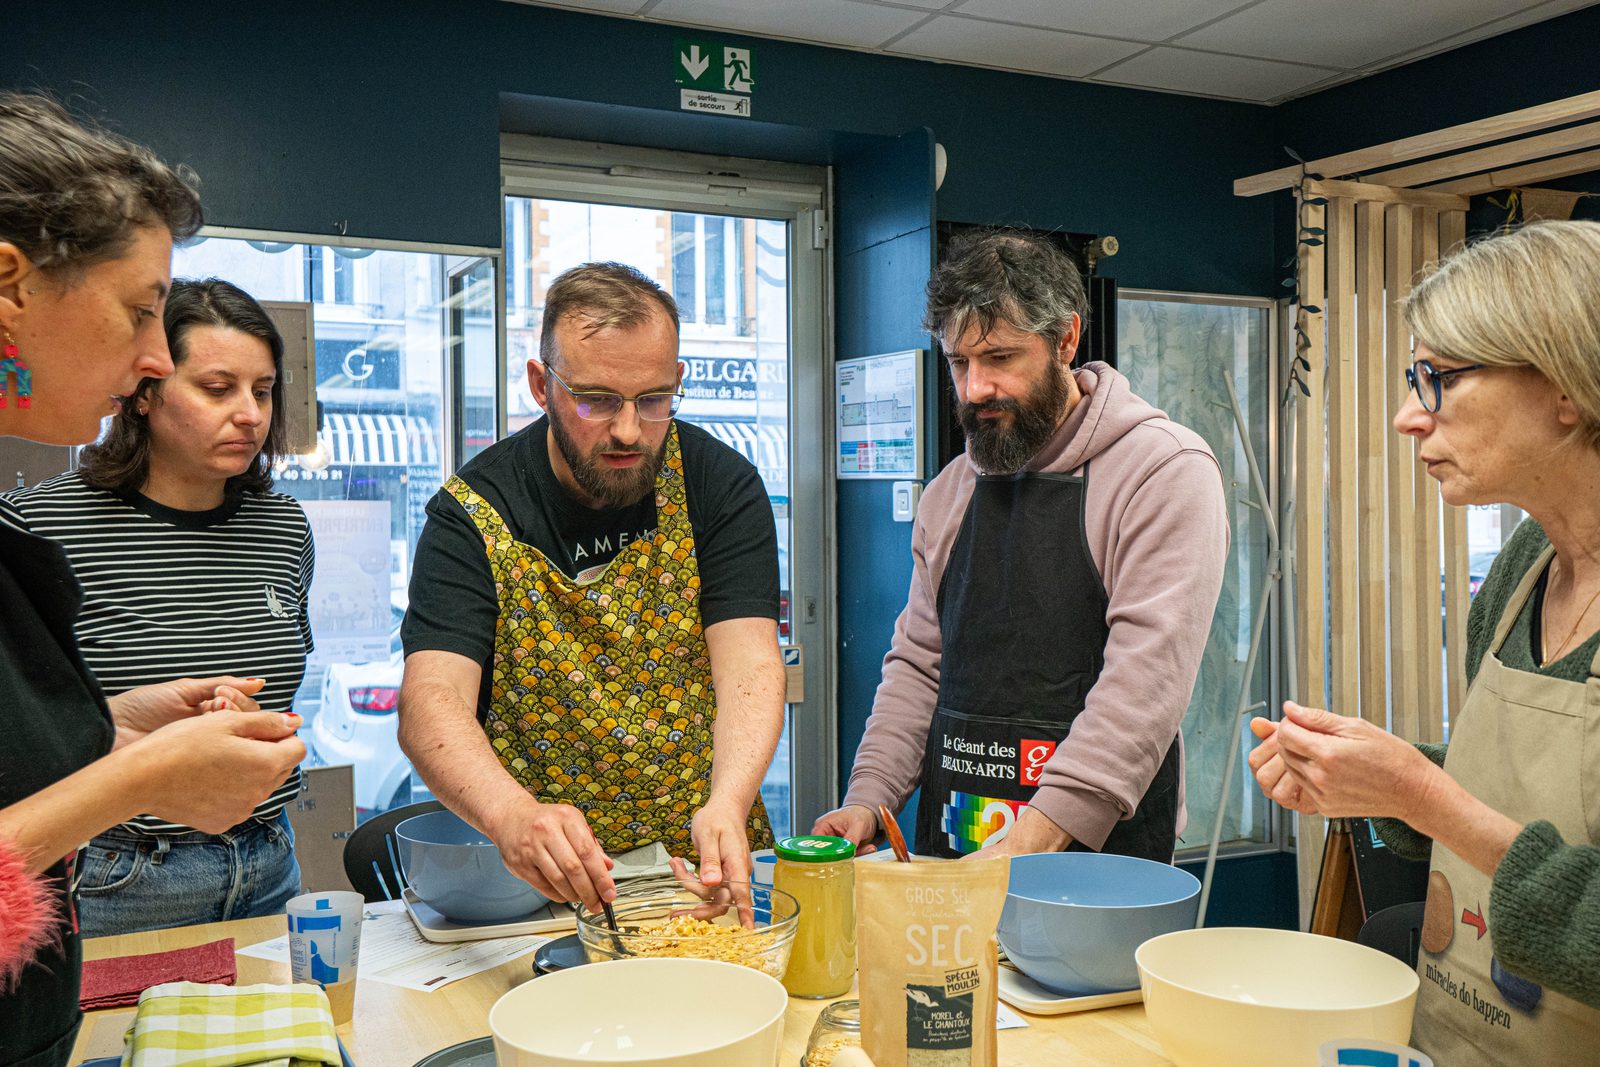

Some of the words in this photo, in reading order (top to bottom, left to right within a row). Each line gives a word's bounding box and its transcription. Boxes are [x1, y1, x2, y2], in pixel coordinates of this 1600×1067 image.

[688, 99, 698, 108] de
[699, 102, 726, 111] secours
[697, 94, 717, 103] sortie
[943, 734, 952, 749] Le
[953, 737, 986, 756] Géant
[988, 741, 1016, 759] des
[941, 754, 1016, 780] BEAUX-ARTS
[905, 887, 944, 905] GROS
[905, 924, 975, 967] SEC
[945, 968, 980, 983] SPÉCIAL
[946, 977, 981, 992] MOULIN
[1425, 962, 1458, 999] miracles
[1459, 981, 1471, 1006] do
[1472, 988, 1512, 1030] happen
[931, 1011, 954, 1020] MOREL
[956, 1010, 965, 1019] et
[923, 1020, 933, 1029] LE
